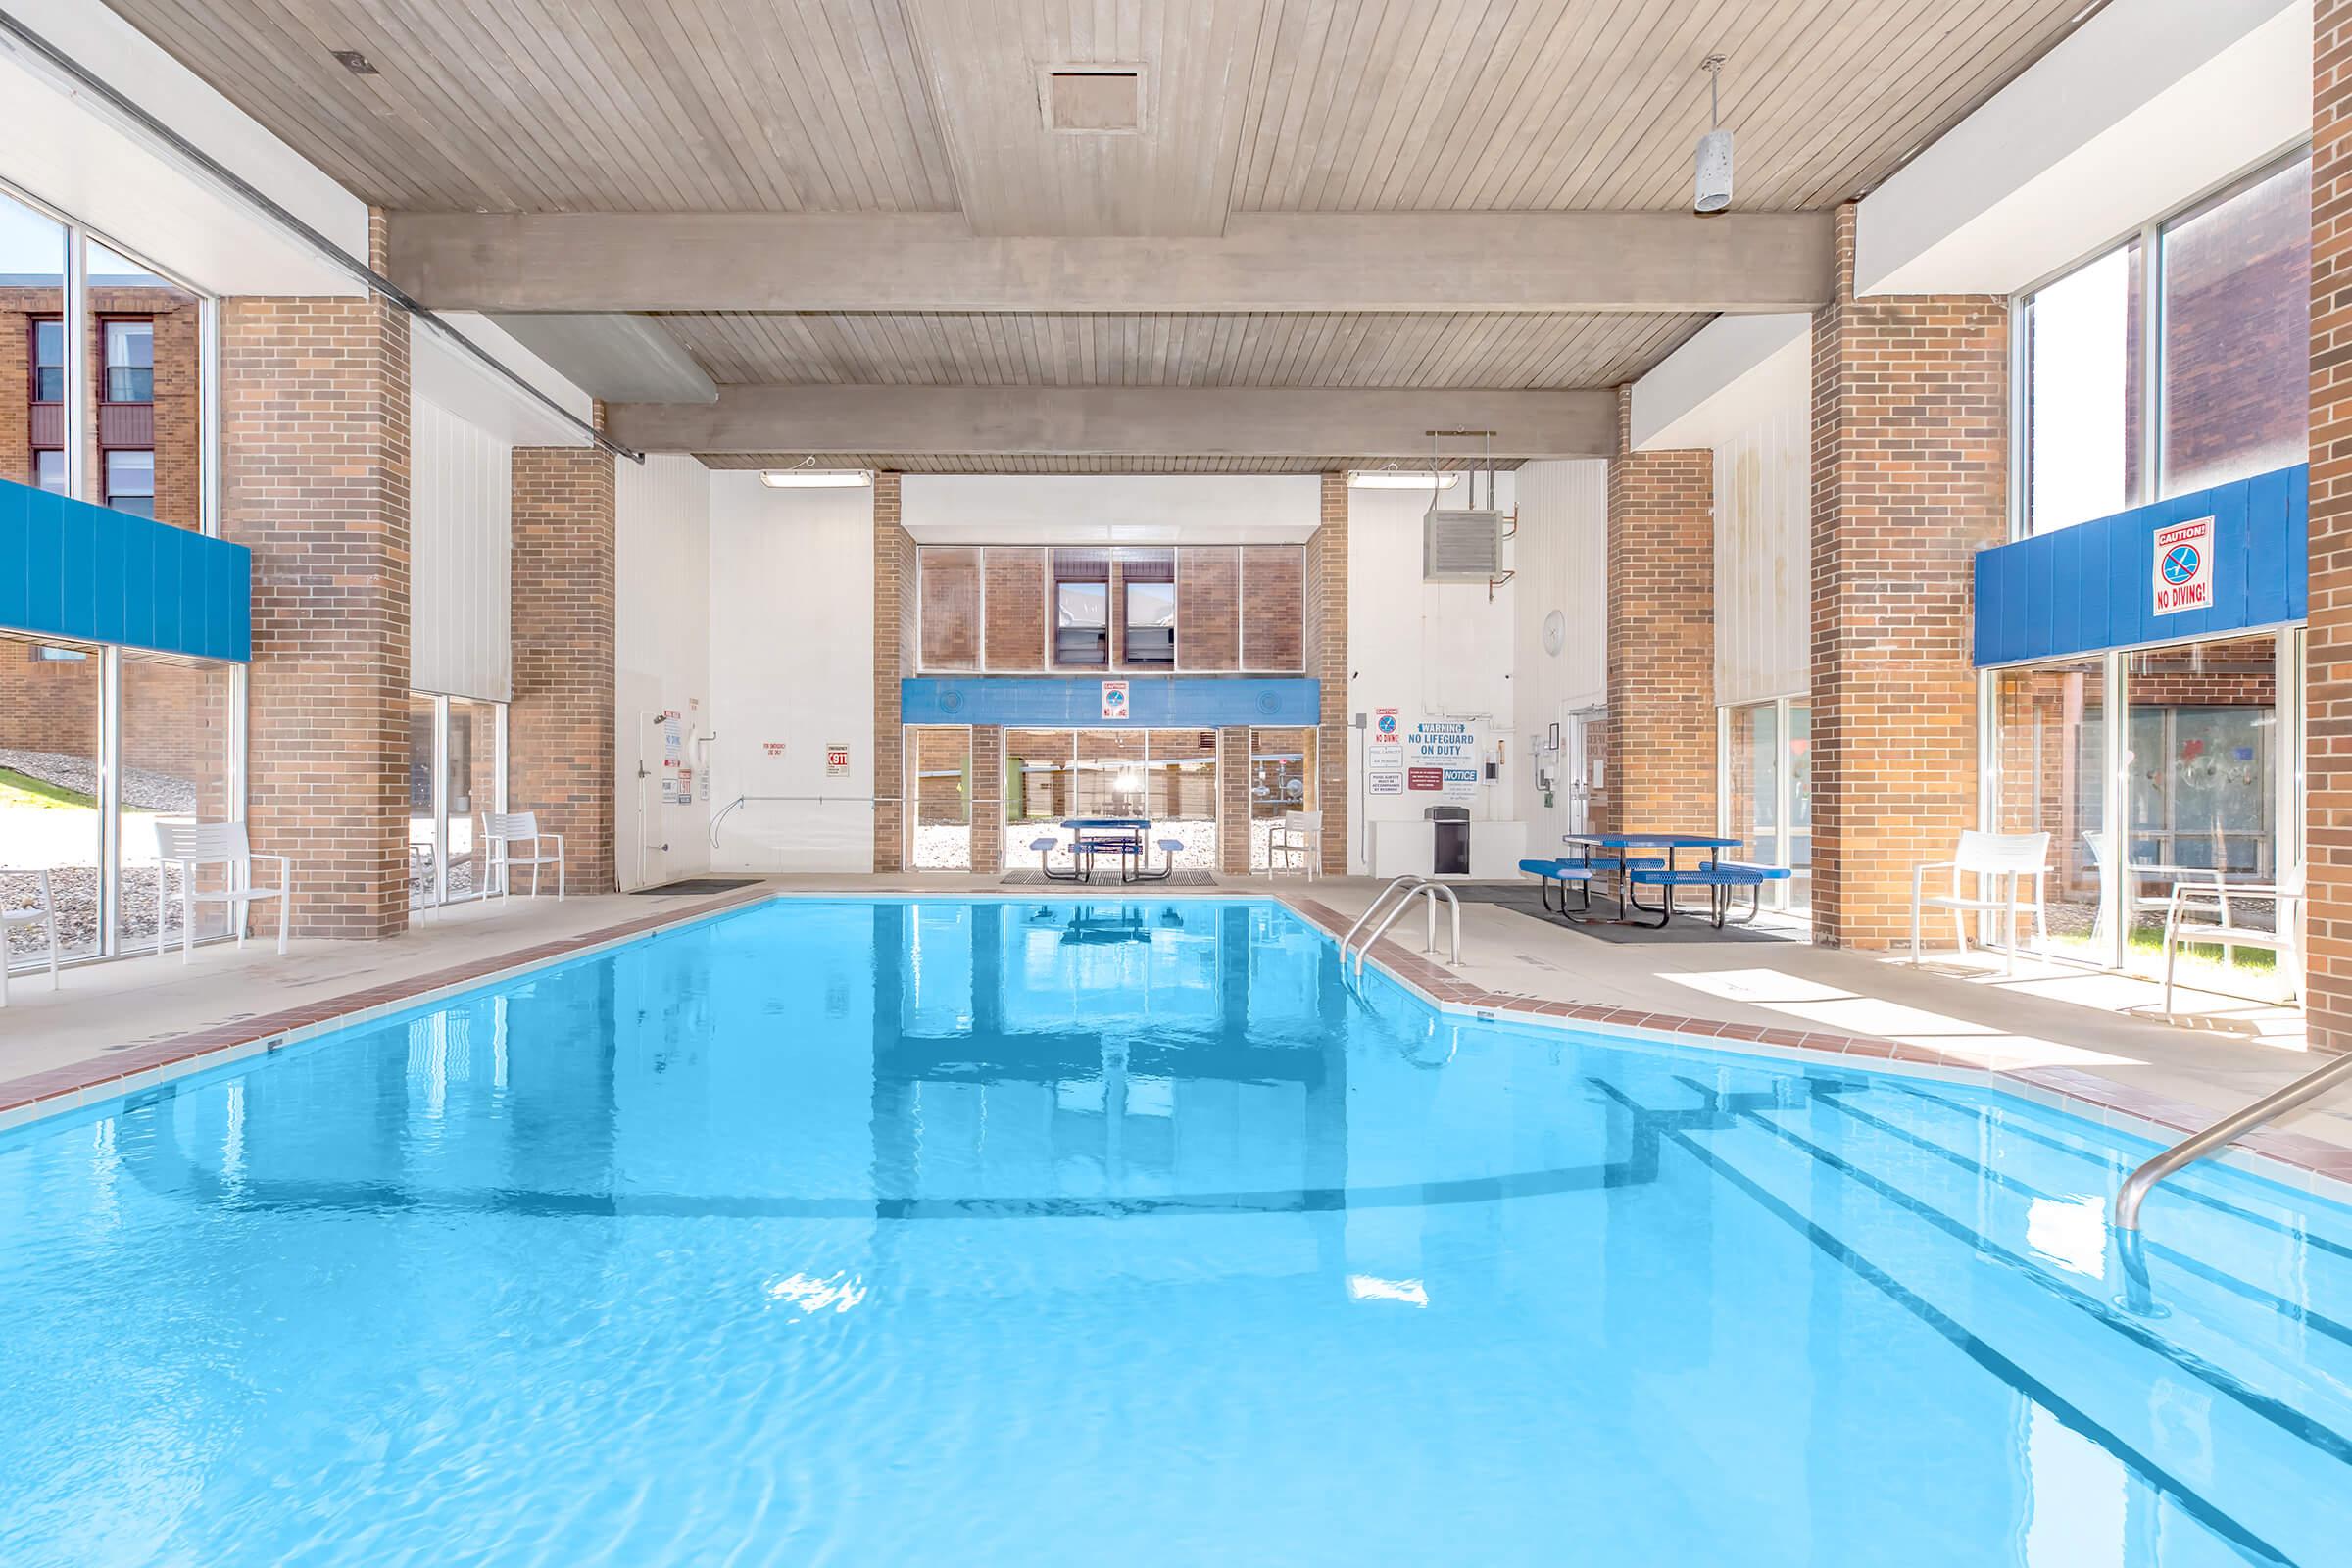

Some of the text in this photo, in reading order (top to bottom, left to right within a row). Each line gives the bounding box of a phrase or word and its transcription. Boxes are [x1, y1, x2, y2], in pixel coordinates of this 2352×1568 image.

[2159, 525, 2205, 545] CAUTION!
[2157, 582, 2206, 609] NO DIVING!
[1423, 723, 1459, 733] WARNING
[1408, 734, 1474, 744] NO LIFEGUARD
[1421, 745, 1461, 755] ON DUTY
[1445, 770, 1476, 781] NOTICE
